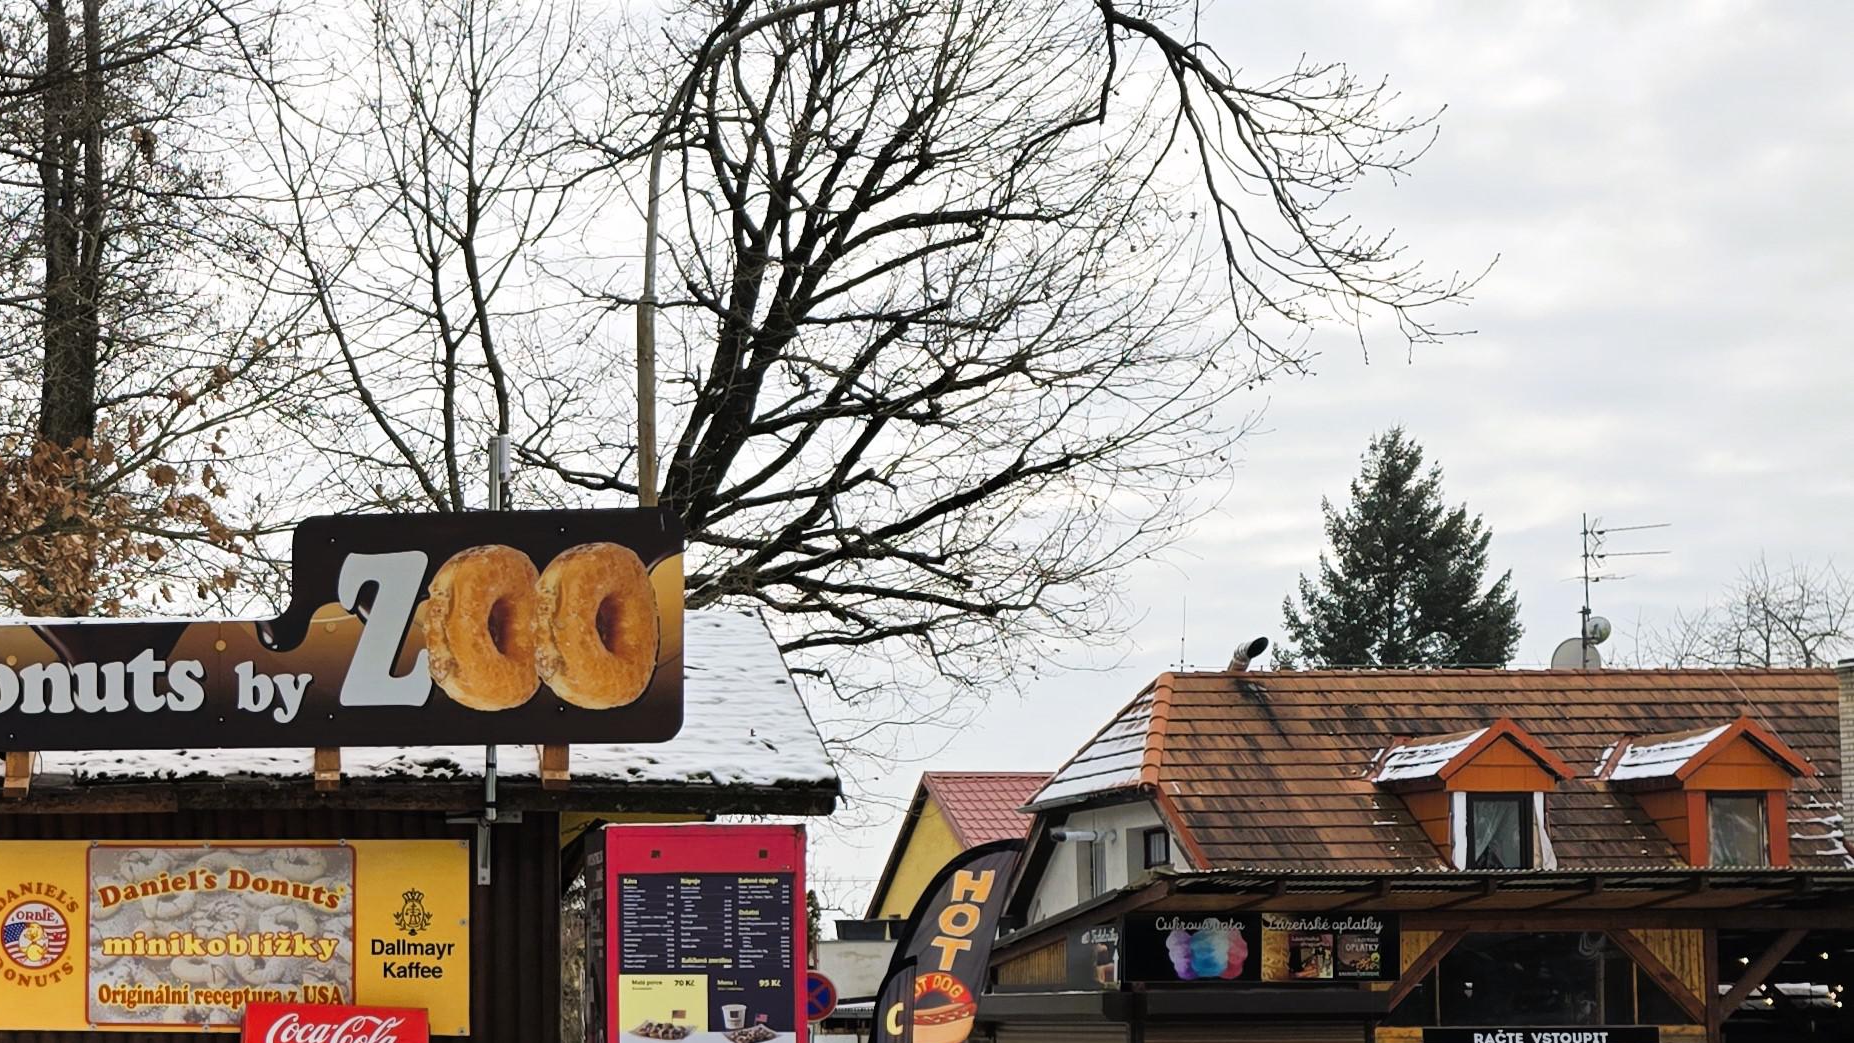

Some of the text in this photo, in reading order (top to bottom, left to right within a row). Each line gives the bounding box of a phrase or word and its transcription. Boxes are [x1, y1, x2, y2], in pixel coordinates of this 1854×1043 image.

[237, 664, 313, 724] by
[227, 868, 341, 910] Donuts
[931, 869, 996, 972] HOT
[1332, 916, 1384, 934] oplatky
[102, 930, 340, 962] minikoblížky
[371, 938, 455, 960] Dallmayr
[1345, 943, 1379, 952] OPLATKY
[383, 961, 443, 979] Kaffee
[98, 983, 344, 1009] Originální receptura z USA
[932, 975, 964, 998] DOG
